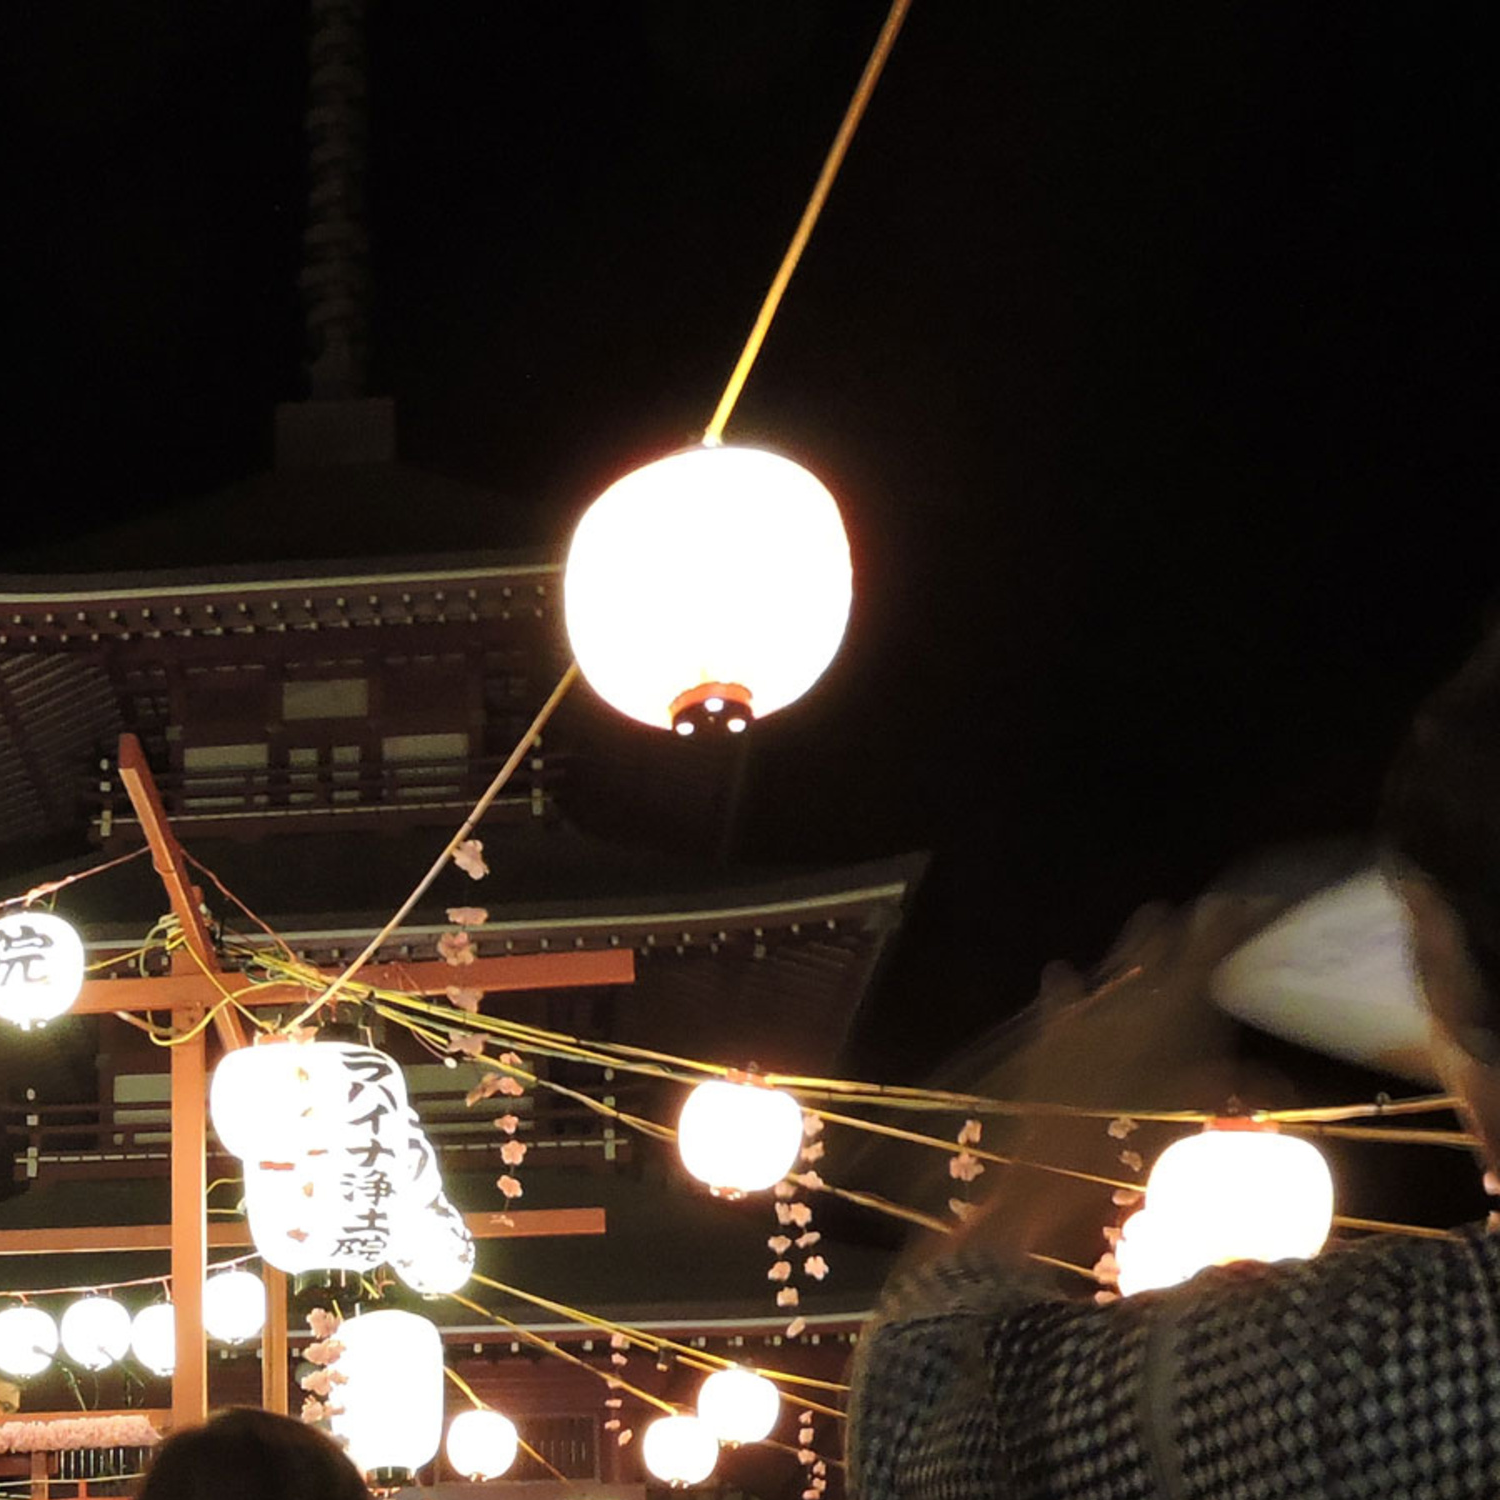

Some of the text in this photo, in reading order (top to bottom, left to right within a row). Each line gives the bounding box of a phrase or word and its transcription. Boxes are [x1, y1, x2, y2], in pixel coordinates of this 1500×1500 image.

[331, 1053, 397, 1262] ラハイナ浄土院
